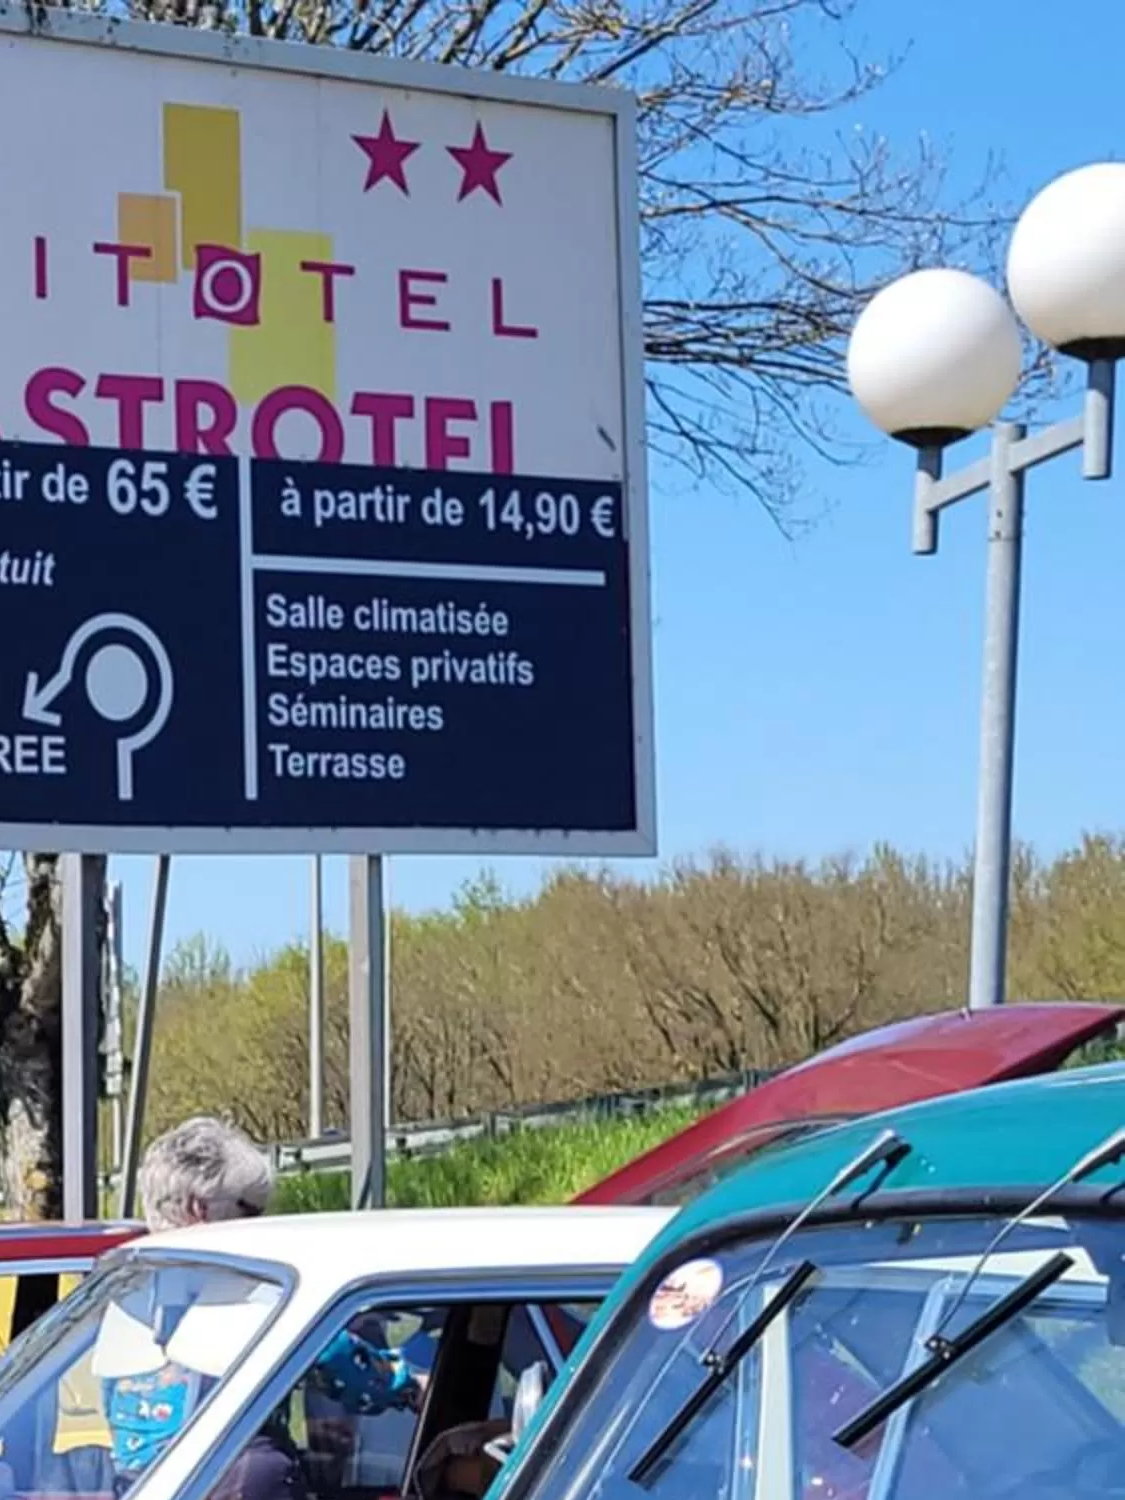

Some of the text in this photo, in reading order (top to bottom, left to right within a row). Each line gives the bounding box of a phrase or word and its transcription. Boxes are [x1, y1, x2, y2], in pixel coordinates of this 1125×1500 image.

[42, 463, 89, 504] de
[107, 459, 169, 516] 65
[184, 463, 217, 519] €
[281, 477, 614, 539] à partir de 14,90 €
[266, 593, 508, 635] Salle climatisée
[267, 643, 534, 688] Espaces privatifs
[268, 693, 444, 730] Séminaires
[268, 743, 405, 778] Terrasse
